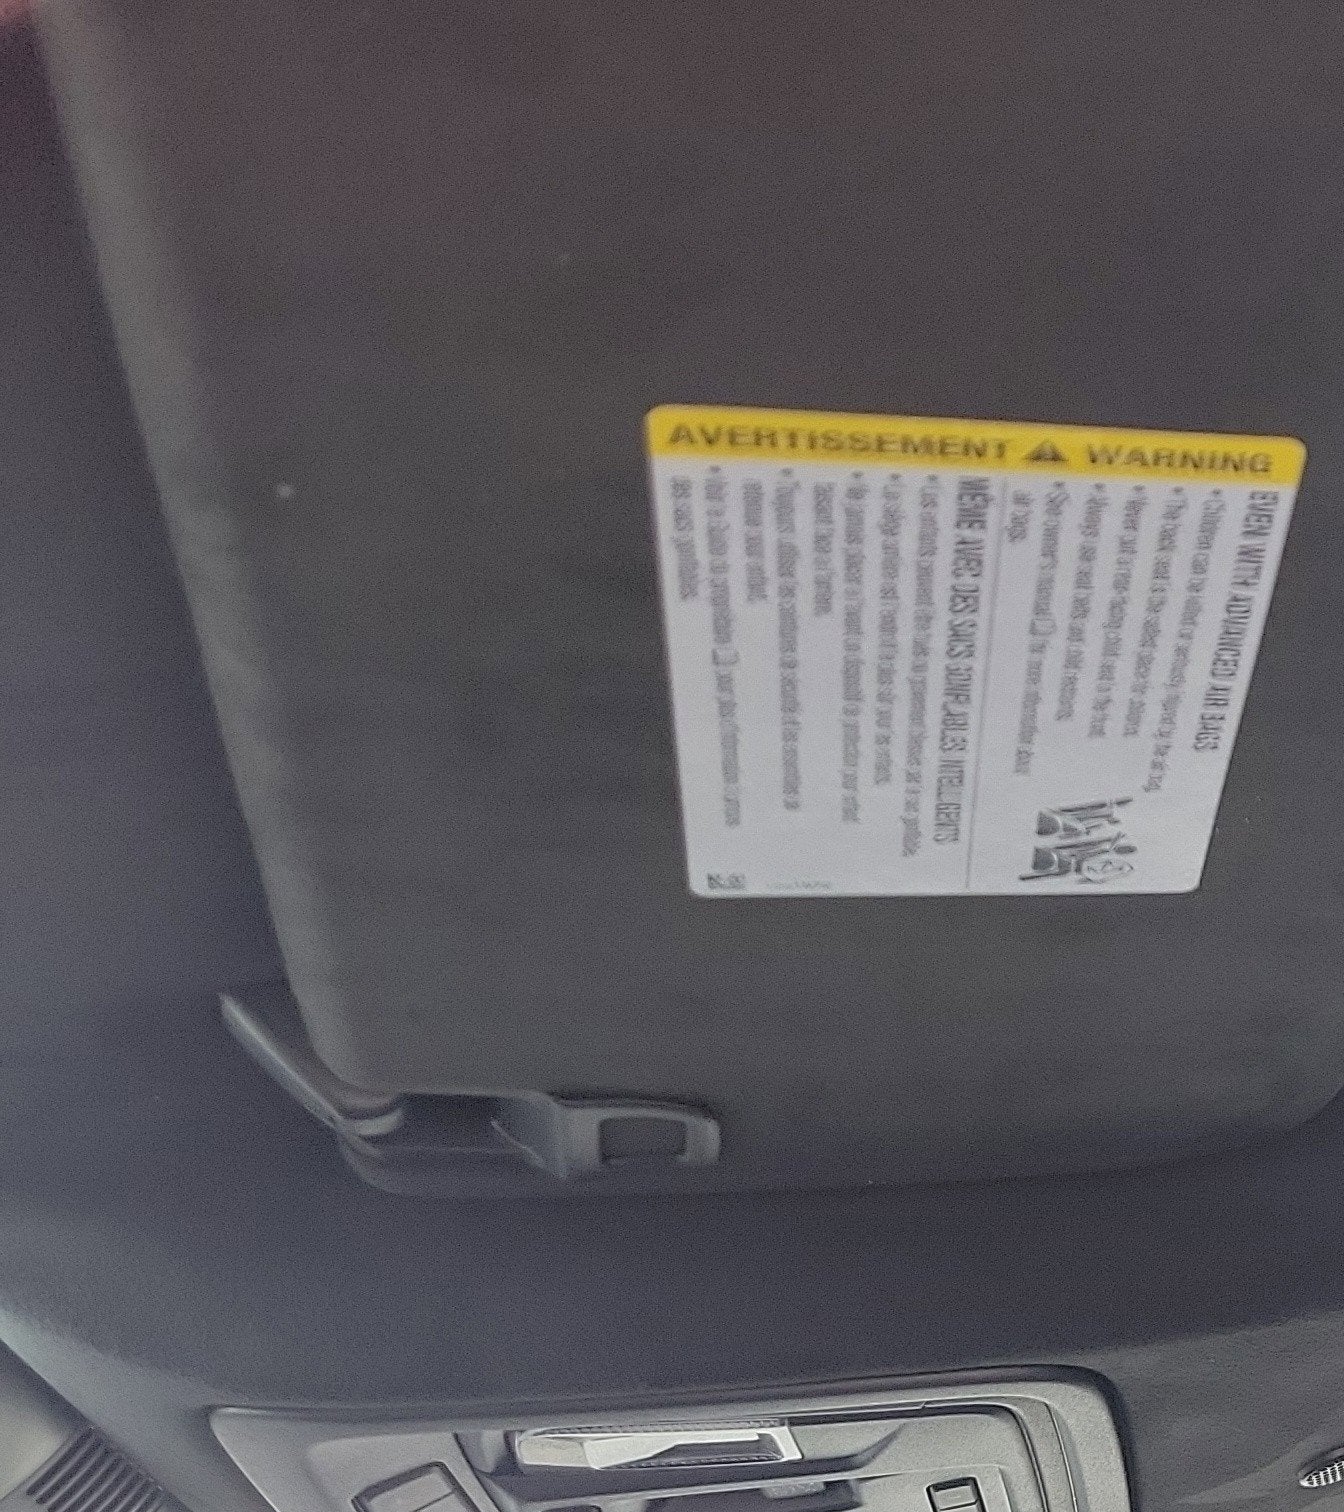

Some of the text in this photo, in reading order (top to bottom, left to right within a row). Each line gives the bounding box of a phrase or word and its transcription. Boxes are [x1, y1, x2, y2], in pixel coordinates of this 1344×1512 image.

[669, 424, 1273, 474] AVERTISSEMENT WARNING
[1238, 490, 1279, 536] EVEN
[1227, 542, 1267, 586] WITH
[1207, 594, 1255, 678] ADVANCED
[1201, 685, 1235, 707] AIR
